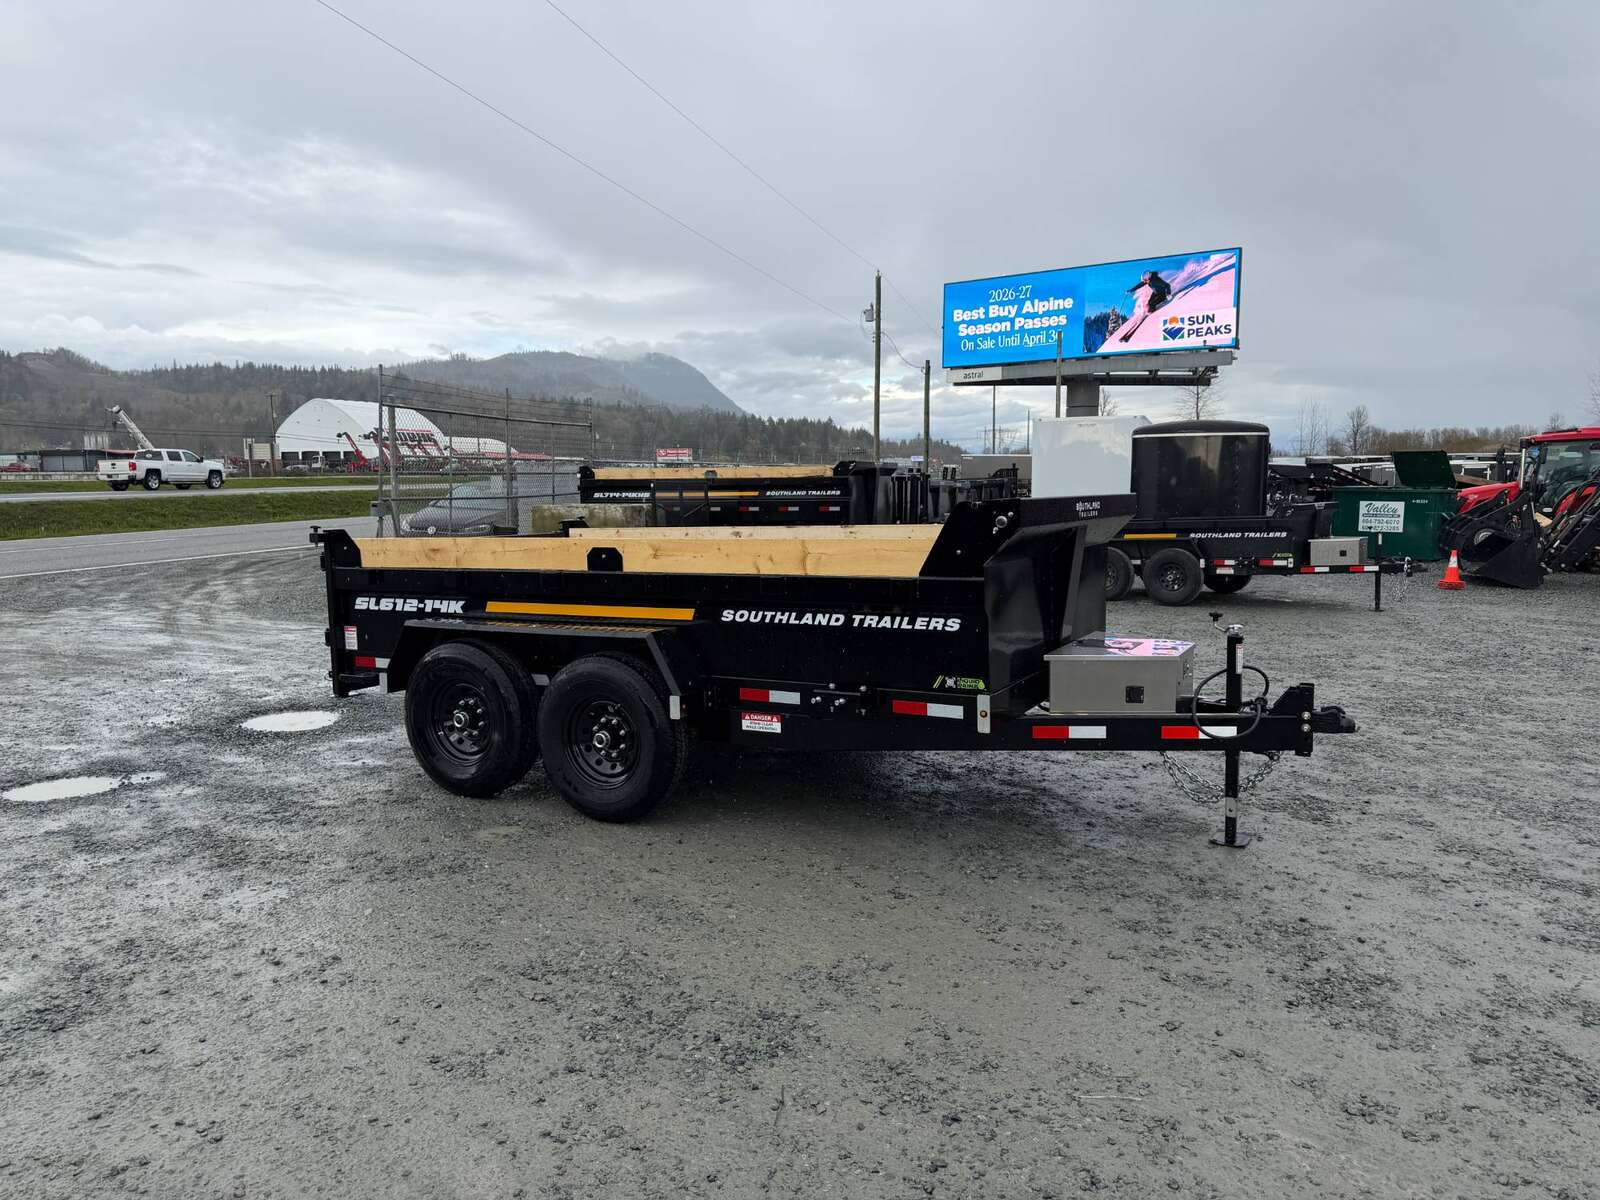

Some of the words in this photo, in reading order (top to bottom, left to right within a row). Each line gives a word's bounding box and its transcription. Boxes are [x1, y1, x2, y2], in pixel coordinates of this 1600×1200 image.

[988, 285, 1032, 303] 2026-27
[953, 306, 985, 322] Best
[988, 304, 1018, 318] Buy
[1021, 297, 1074, 315] Alpine
[958, 320, 1011, 337] Season
[1014, 314, 1067, 330] Passes
[1187, 313, 1215, 326] SUN
[1187, 324, 1232, 338] PEAKS
[961, 339, 974, 351] On
[976, 337, 996, 350] Sale
[998, 334, 1020, 348] Until
[1022, 330, 1046, 347] April
[963, 371, 984, 379] astral
[354, 597, 466, 613] SL612-14K
[721, 609, 845, 626] SOUTHLAND
[852, 614, 962, 632] TRAILERS
